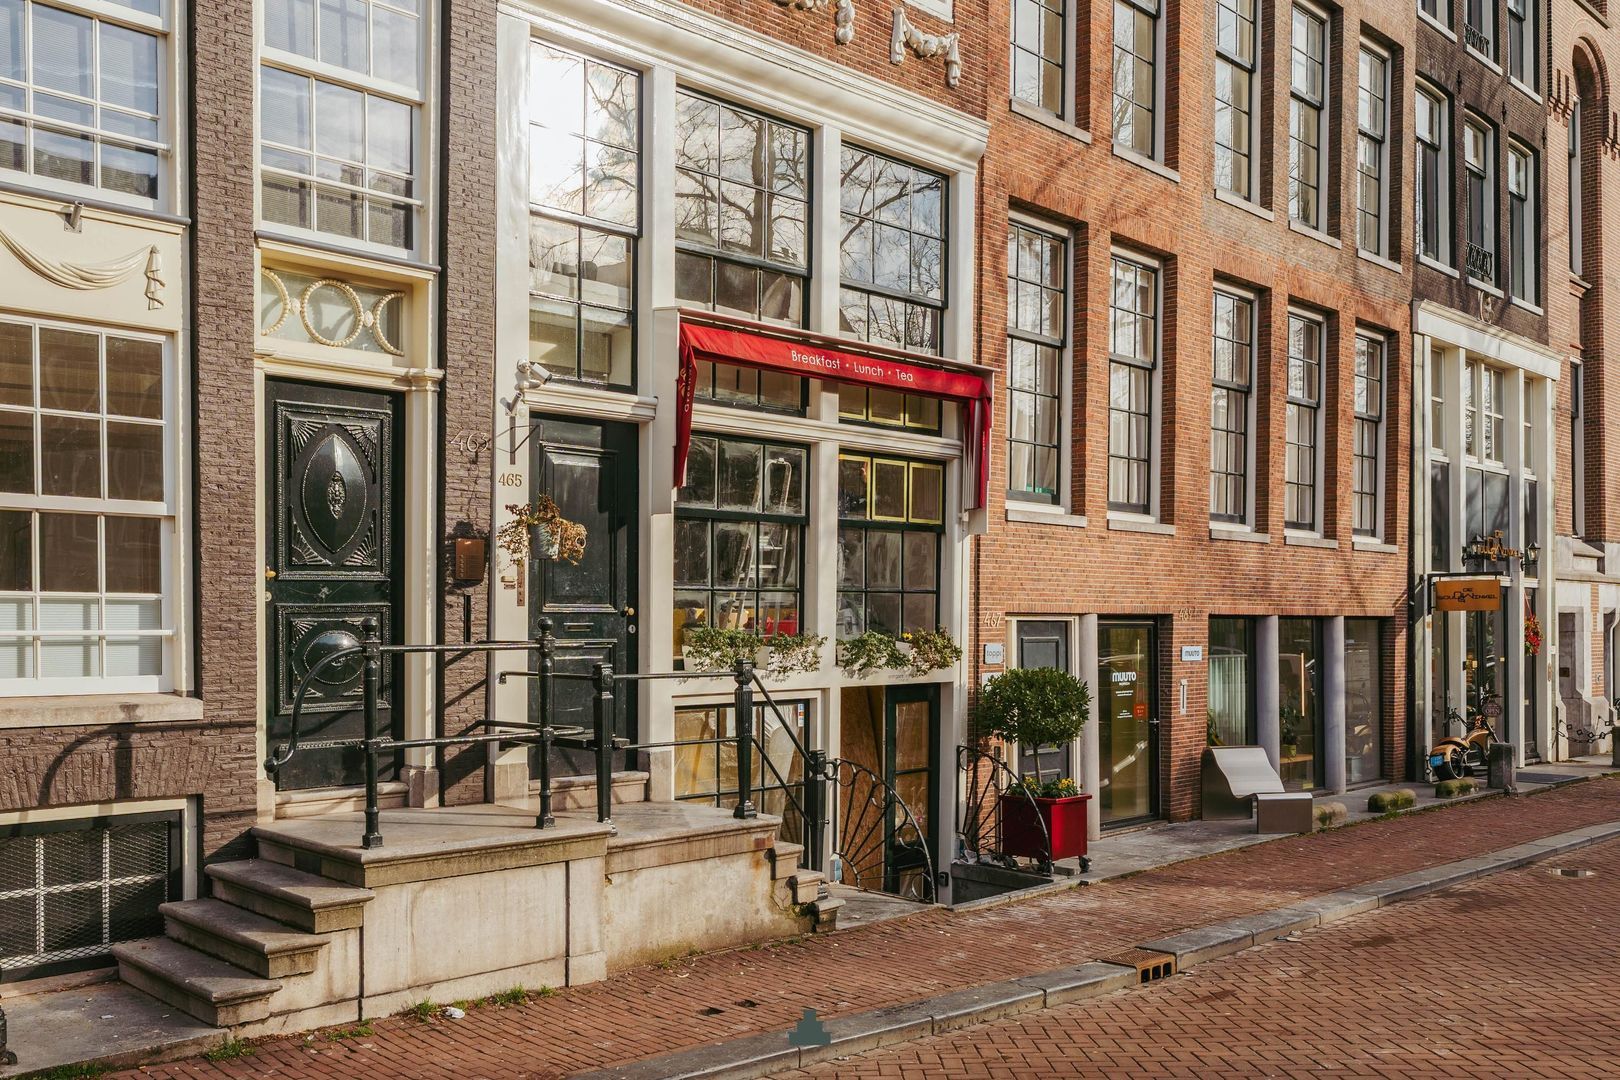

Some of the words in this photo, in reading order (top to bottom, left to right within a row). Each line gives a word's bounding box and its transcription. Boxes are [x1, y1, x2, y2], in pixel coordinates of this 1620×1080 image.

[791, 350, 840, 369] Breakfast
[853, 362, 884, 376] Lunch
[895, 369, 913, 382] Tea
[450, 430, 489, 453] 463
[498, 473, 523, 488] 465
[983, 611, 1002, 628] 467
